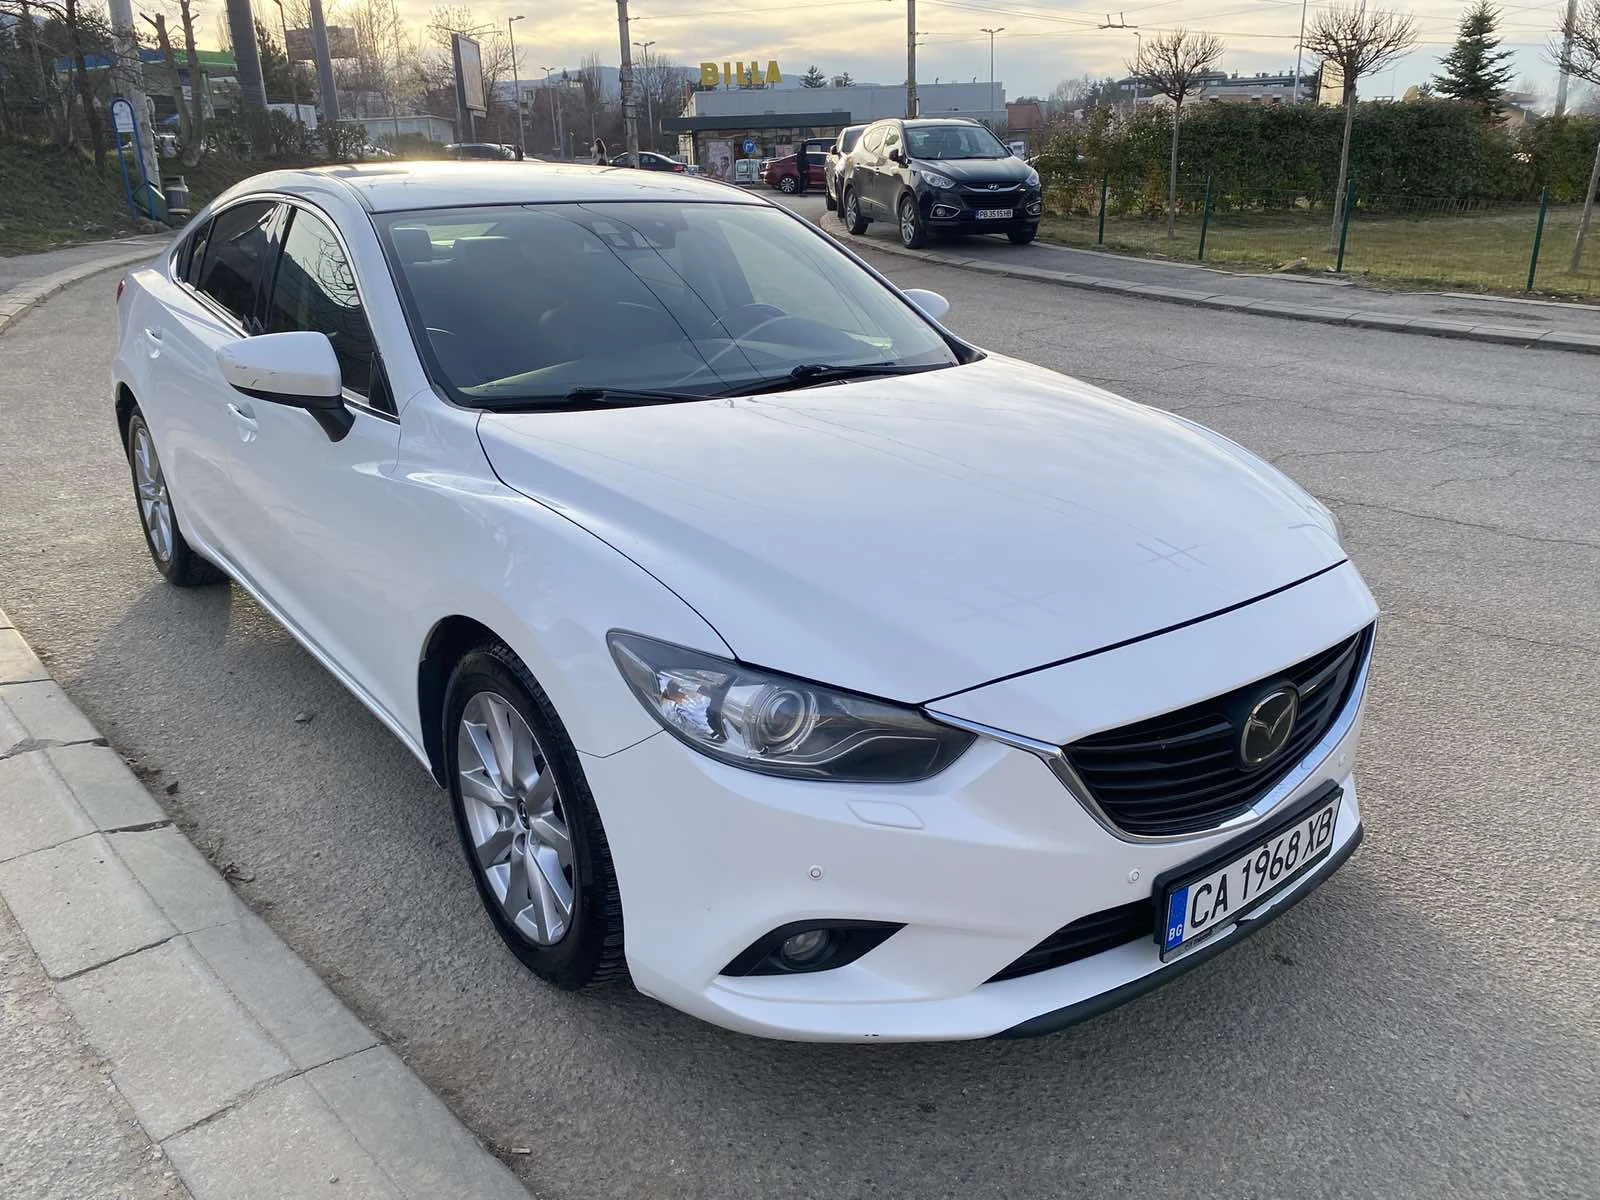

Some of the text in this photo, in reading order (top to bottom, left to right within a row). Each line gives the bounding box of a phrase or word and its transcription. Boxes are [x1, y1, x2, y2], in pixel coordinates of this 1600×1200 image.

[701, 61, 783, 86] BILLA
[1191, 806, 1334, 929] CA 1968 XB
[1168, 923, 1183, 941] BG
